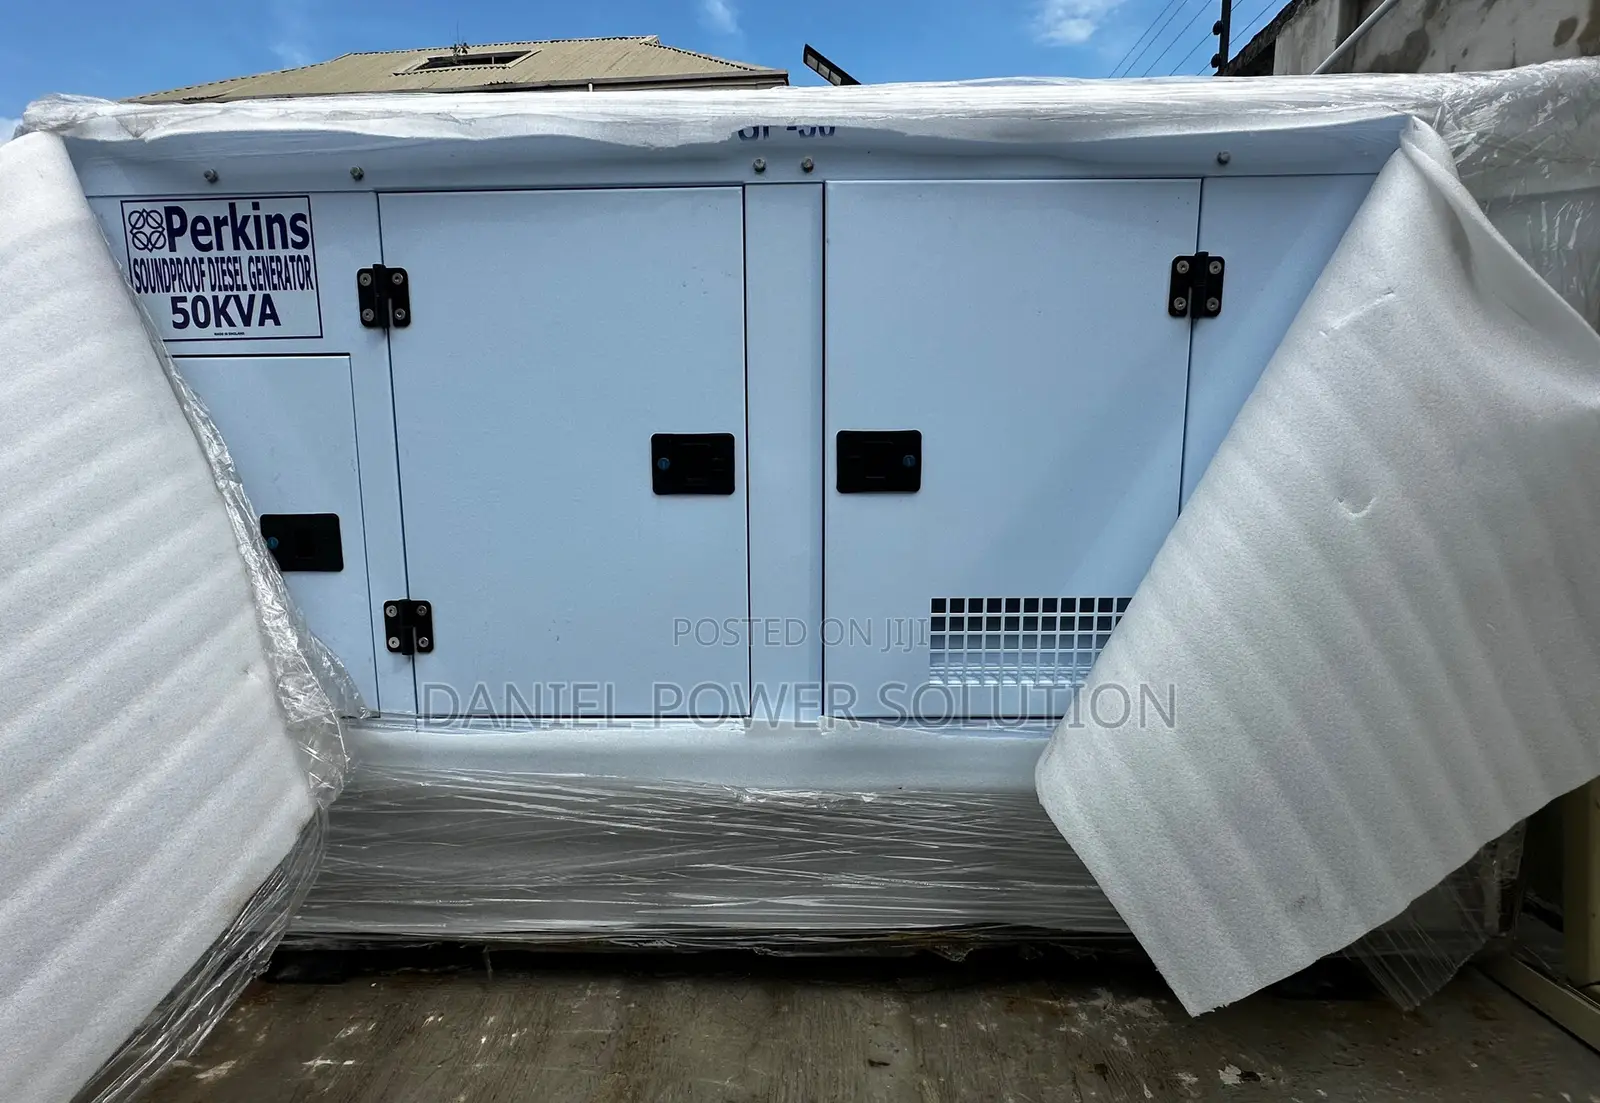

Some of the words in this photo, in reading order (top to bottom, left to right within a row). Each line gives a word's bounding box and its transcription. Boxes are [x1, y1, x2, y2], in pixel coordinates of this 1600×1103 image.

[164, 201, 310, 252] Perkins
[133, 256, 206, 294] SOUNDPROOF
[207, 256, 247, 292] DIESEL
[248, 254, 314, 291] GENERATOR
[170, 293, 281, 330] 50KVA
